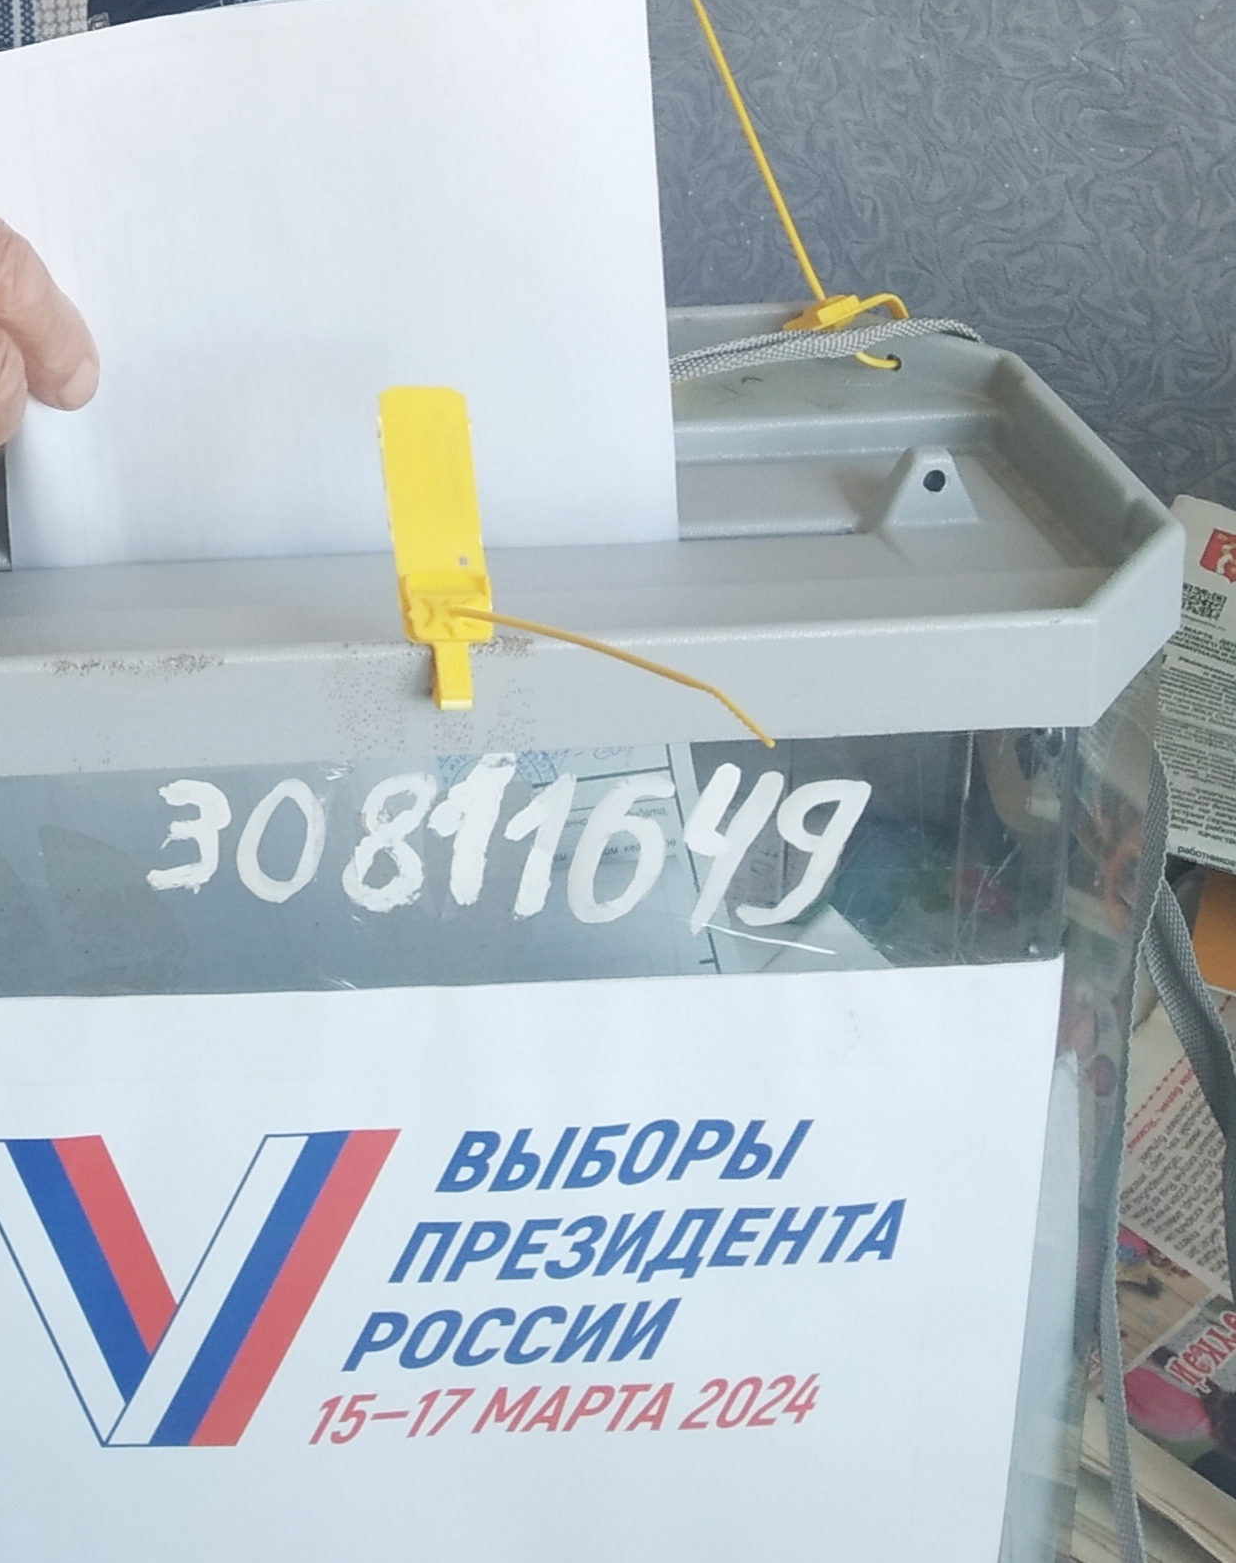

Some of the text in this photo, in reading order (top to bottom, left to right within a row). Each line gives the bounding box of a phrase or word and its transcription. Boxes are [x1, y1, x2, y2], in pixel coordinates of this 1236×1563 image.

[146, 752, 872, 935] 30811649
[436, 1119, 813, 1193] ВЫБОРЫ
[389, 1198, 906, 1284] ПРЕЗИДЕНТА
[343, 1298, 681, 1372] РОССИИ
[470, 1383, 675, 1434] МАРТА
[678, 1373, 822, 1431] 2024
